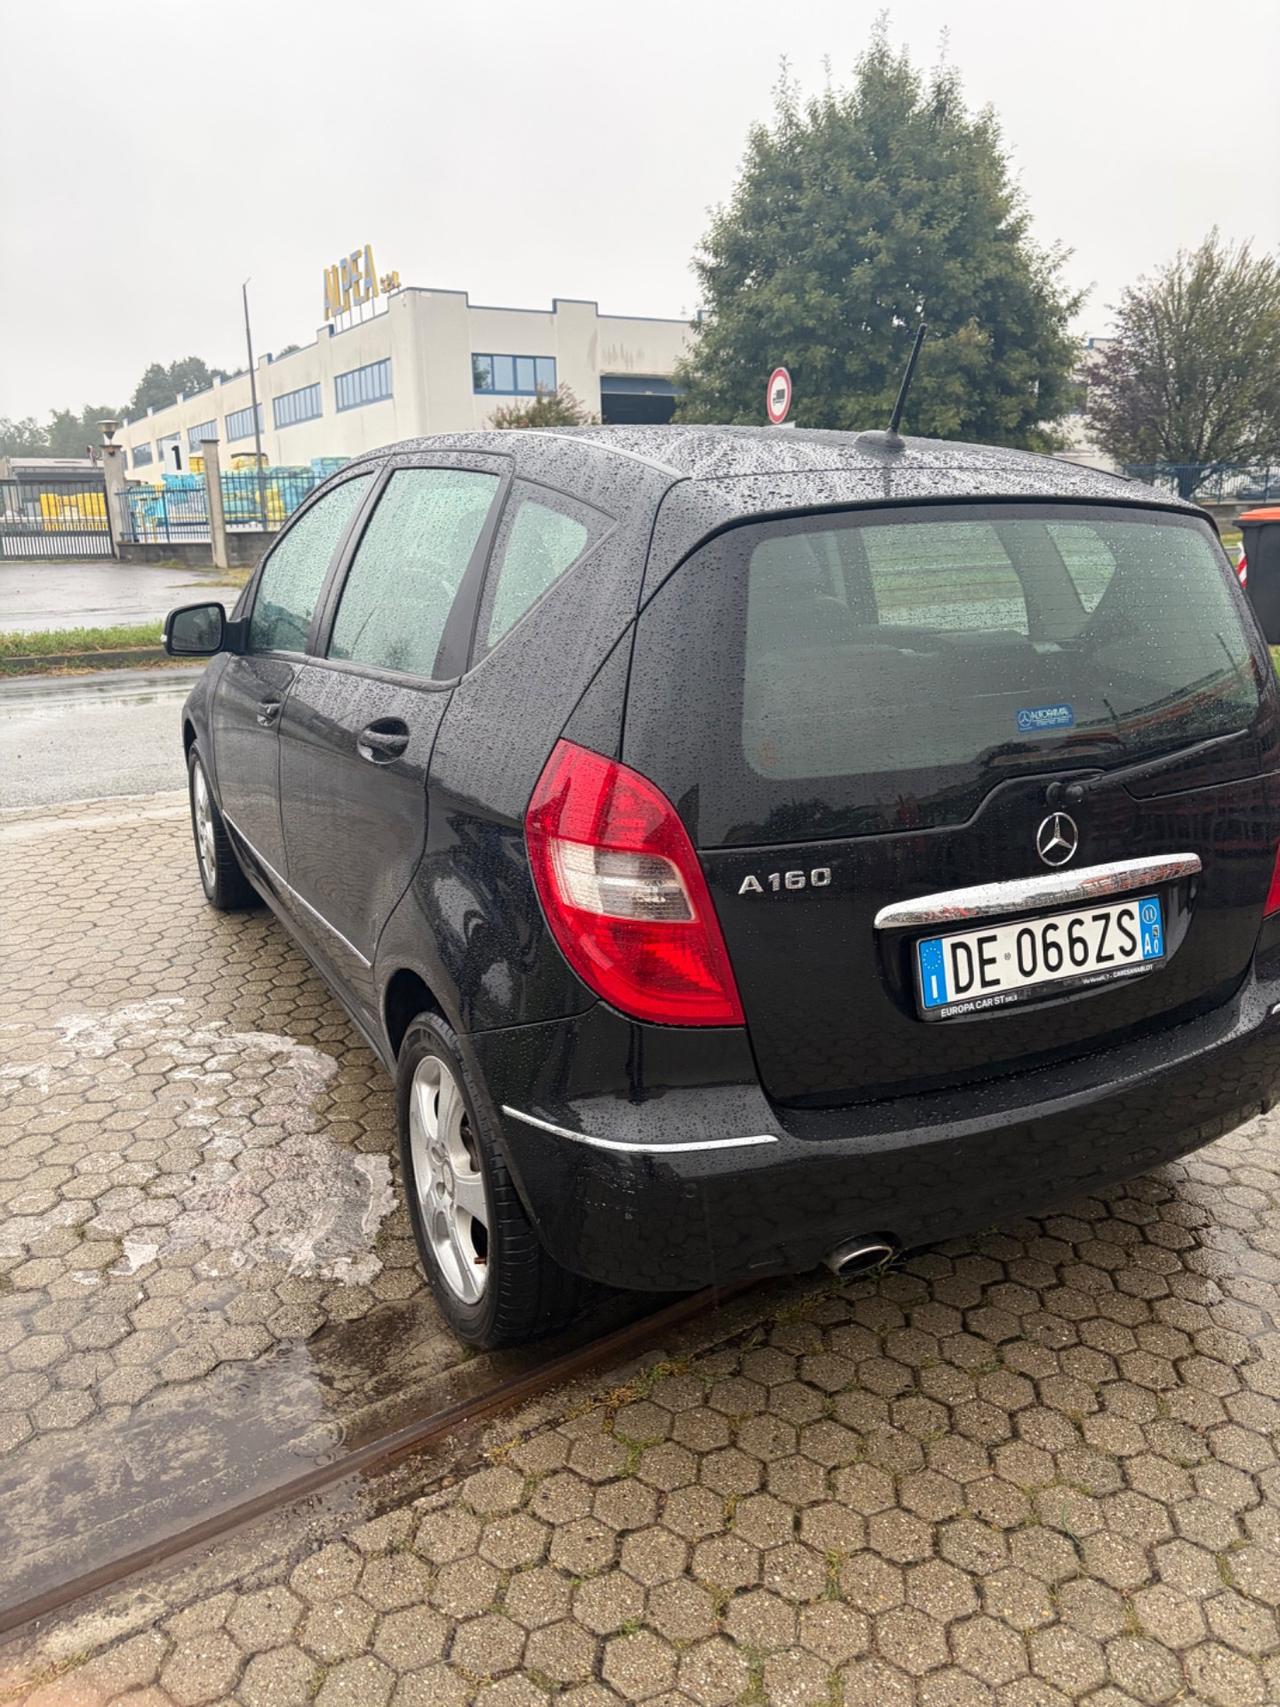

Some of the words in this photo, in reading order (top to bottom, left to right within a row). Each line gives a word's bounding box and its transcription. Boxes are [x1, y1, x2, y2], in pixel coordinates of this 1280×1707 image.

[171, 445, 182, 470] 1
[950, 935, 1001, 995] DE
[1016, 908, 1138, 978] 066ZS
[940, 1002, 975, 1018] EUROPA
[975, 997, 994, 1010] CAR
[994, 994, 1006, 1006] ST
